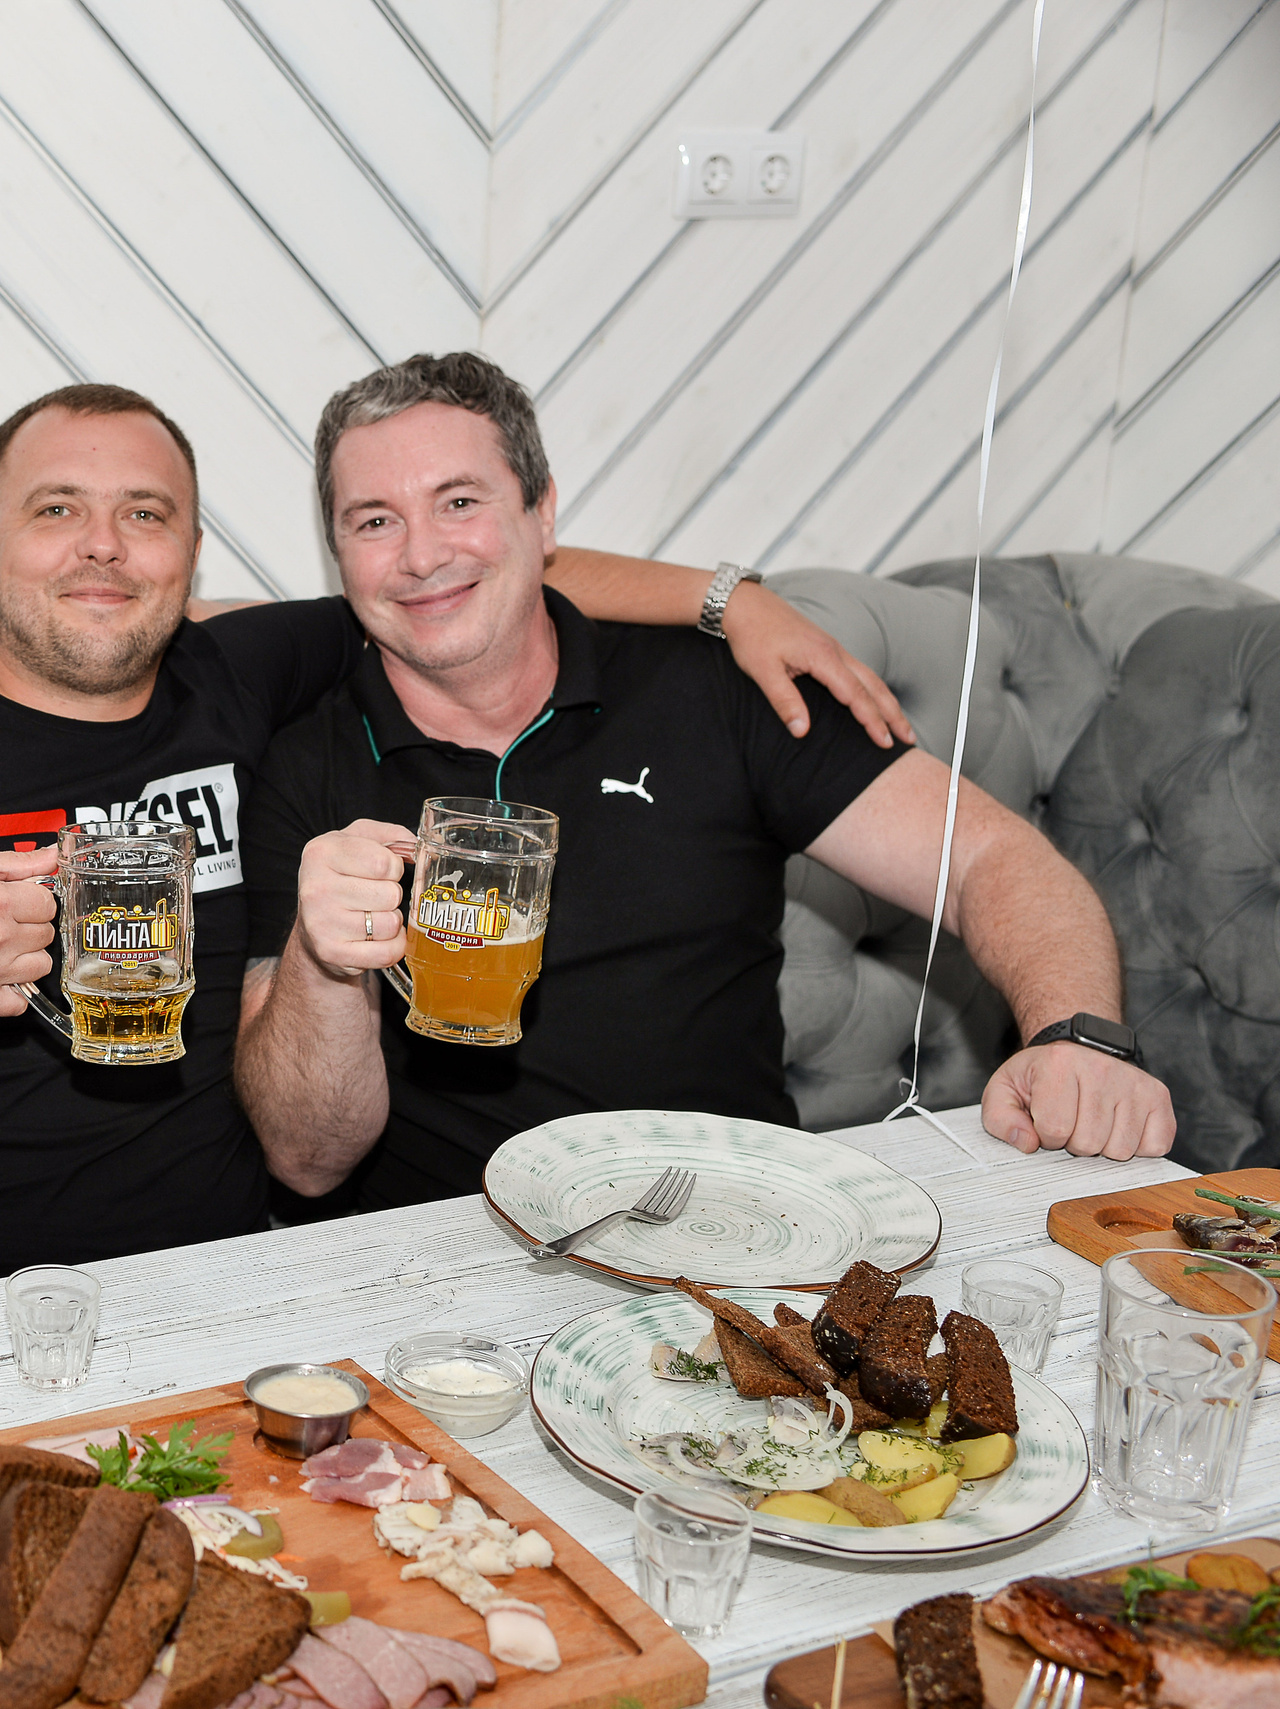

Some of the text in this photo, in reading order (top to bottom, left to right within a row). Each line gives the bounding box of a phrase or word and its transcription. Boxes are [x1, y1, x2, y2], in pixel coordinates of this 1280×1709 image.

[207, 859, 237, 874] LIVING
[418, 898, 477, 933] ПИНТА
[86, 921, 151, 949] ПИНТА
[431, 930, 478, 945] пивоварня
